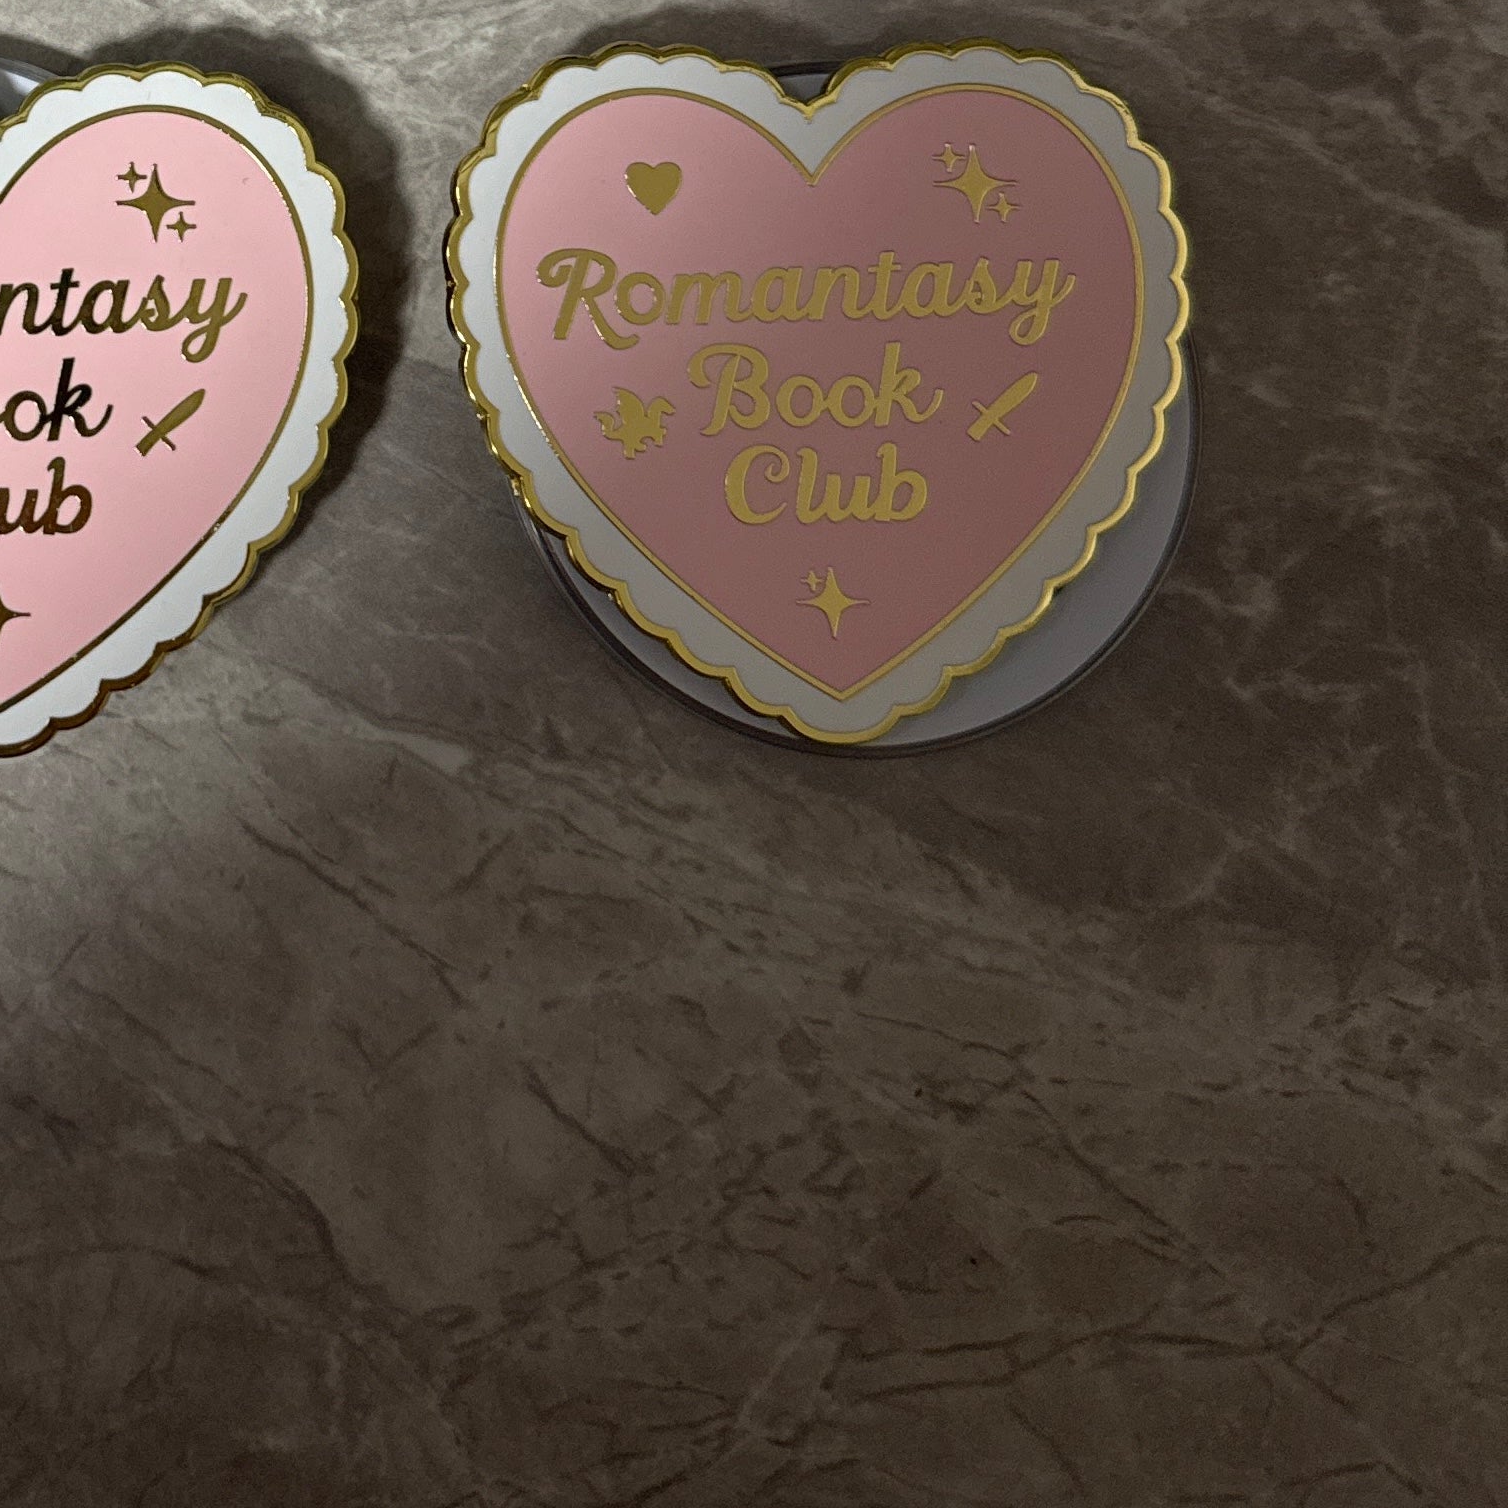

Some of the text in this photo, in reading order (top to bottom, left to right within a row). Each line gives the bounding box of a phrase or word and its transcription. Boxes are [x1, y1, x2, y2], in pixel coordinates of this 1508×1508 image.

[536, 248, 1076, 351] Romantasy
[688, 342, 944, 436] Book
[724, 442, 928, 526] Club
